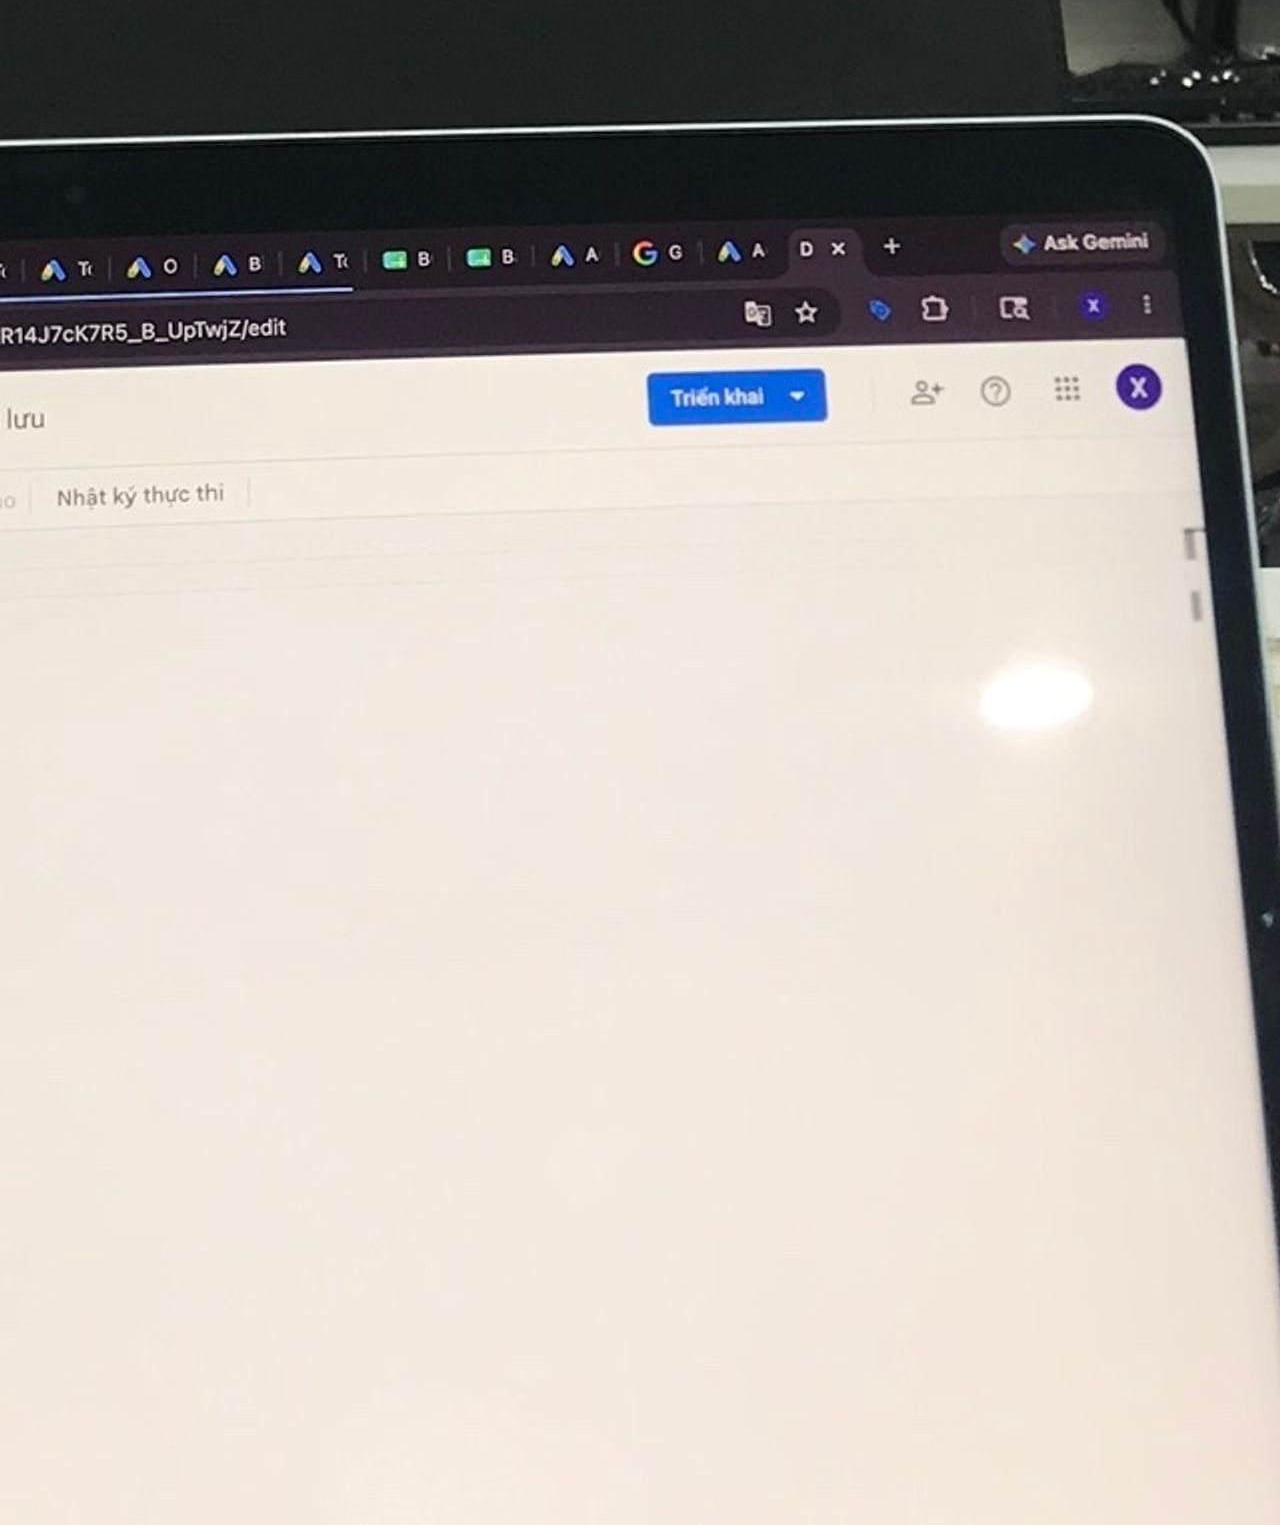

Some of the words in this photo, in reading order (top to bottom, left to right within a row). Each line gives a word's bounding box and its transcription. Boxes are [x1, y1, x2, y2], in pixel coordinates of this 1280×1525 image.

[799, 241, 814, 257] D
[1043, 234, 1079, 251] Ask
[1082, 232, 1149, 251] Gemini
[723, 386, 764, 406] khai
[1129, 377, 1148, 399] X
[6, 407, 46, 430] lưu
[57, 487, 107, 511] Nhật
[113, 485, 137, 509] ký
[144, 485, 191, 508] thực
[196, 483, 224, 502] thi
